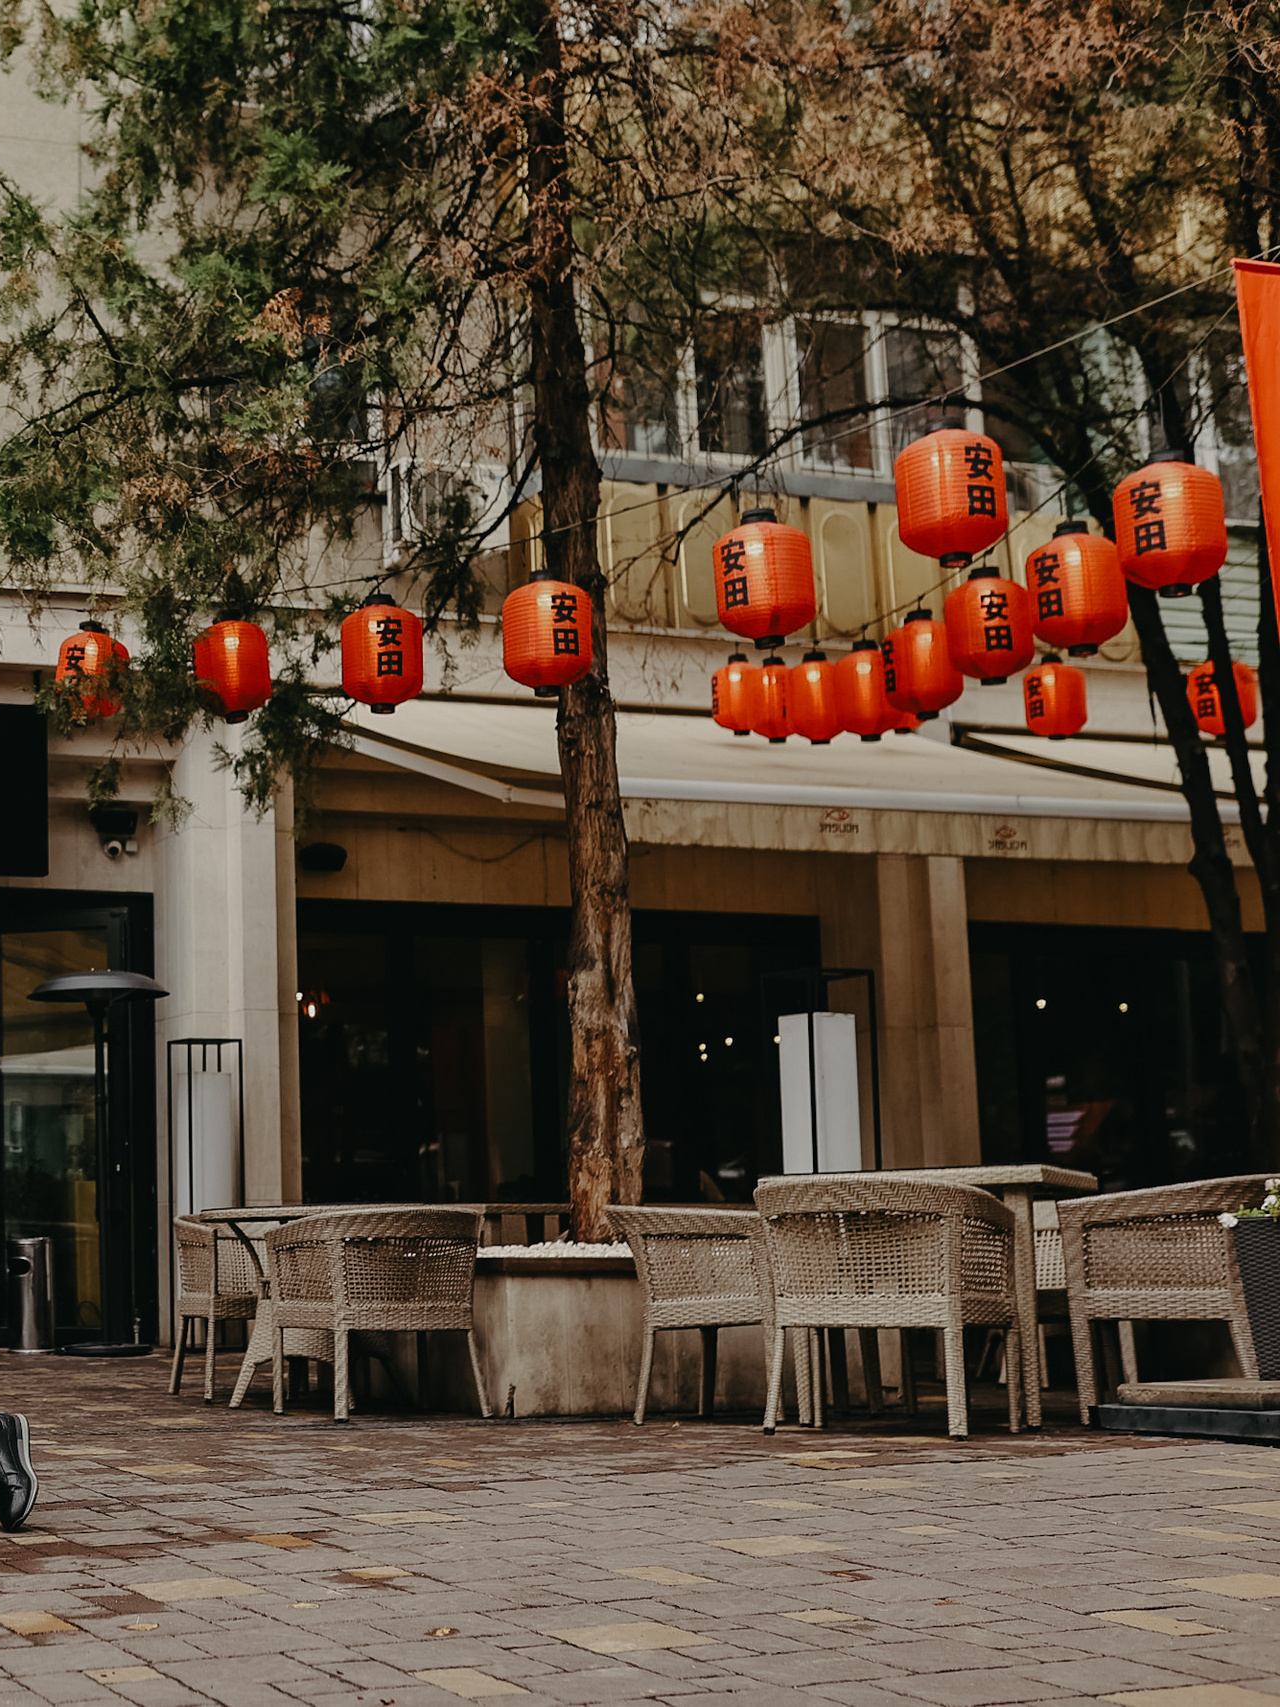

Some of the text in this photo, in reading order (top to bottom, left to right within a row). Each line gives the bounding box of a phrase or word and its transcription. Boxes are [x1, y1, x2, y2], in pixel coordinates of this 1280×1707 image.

[964, 442, 997, 519] 安田
[1130, 481, 1168, 556] 安田
[720, 539, 750, 611] 安田
[1033, 552, 1065, 622] 安田
[375, 616, 404, 678] 安田
[550, 592, 581, 657] 安田
[980, 590, 1014, 652] 安田
[1028, 677, 1045, 719] 安田
